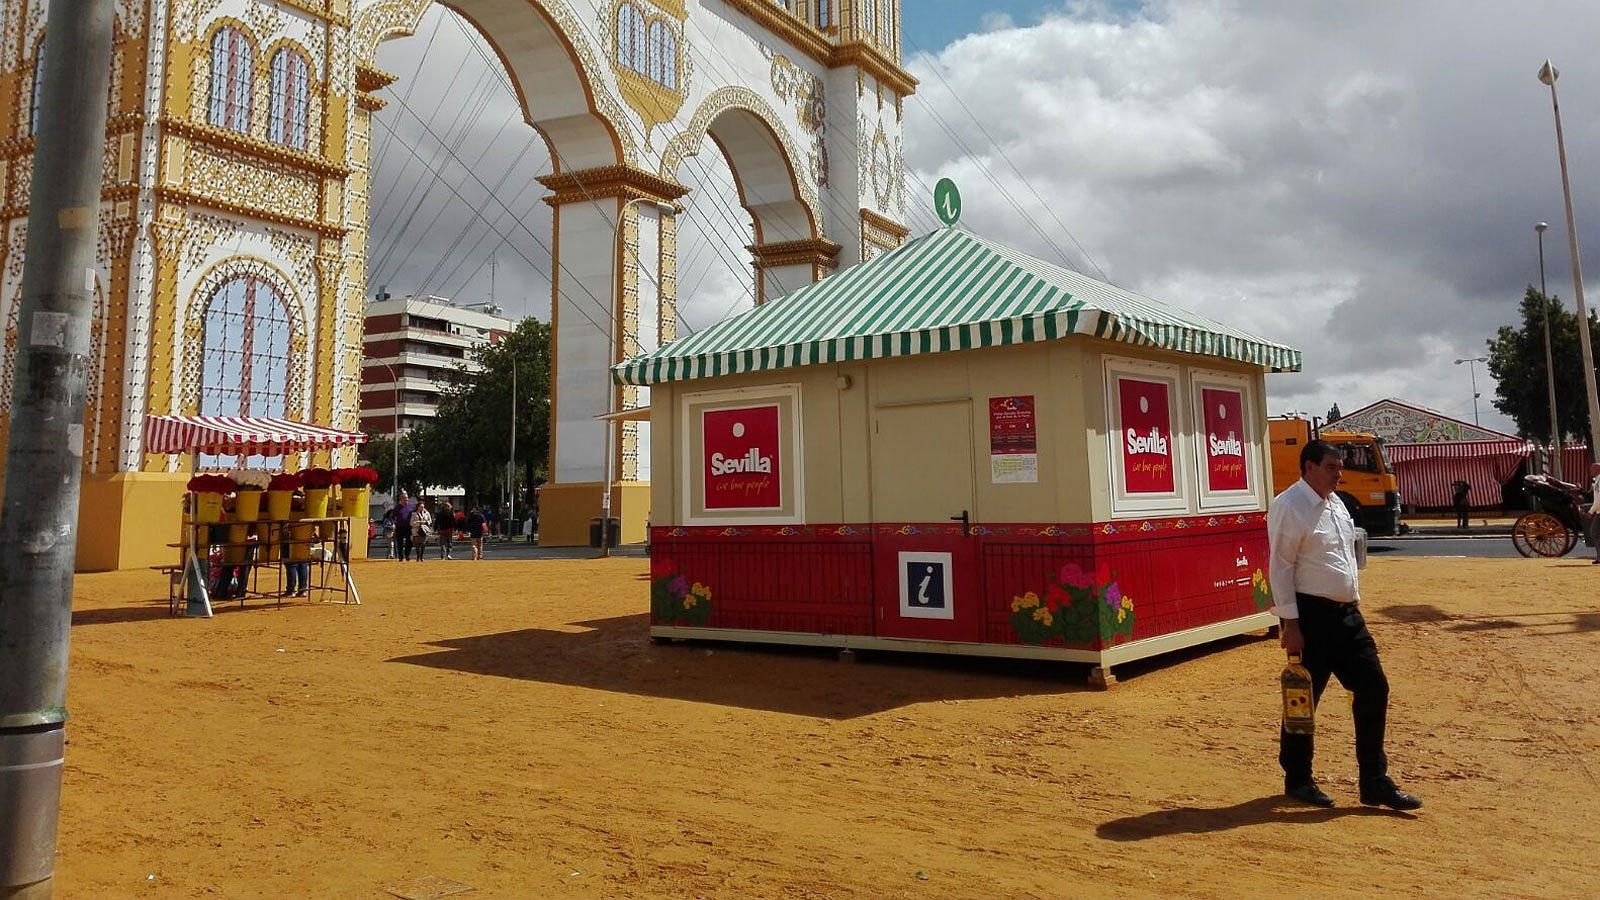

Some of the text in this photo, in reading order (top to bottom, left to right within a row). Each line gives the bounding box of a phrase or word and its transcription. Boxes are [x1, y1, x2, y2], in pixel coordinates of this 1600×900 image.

[1375, 416, 1401, 426] ABC
[1127, 426, 1167, 455] Sevilla
[1209, 430, 1242, 456] Sevilla
[711, 447, 771, 476] Sevilla
